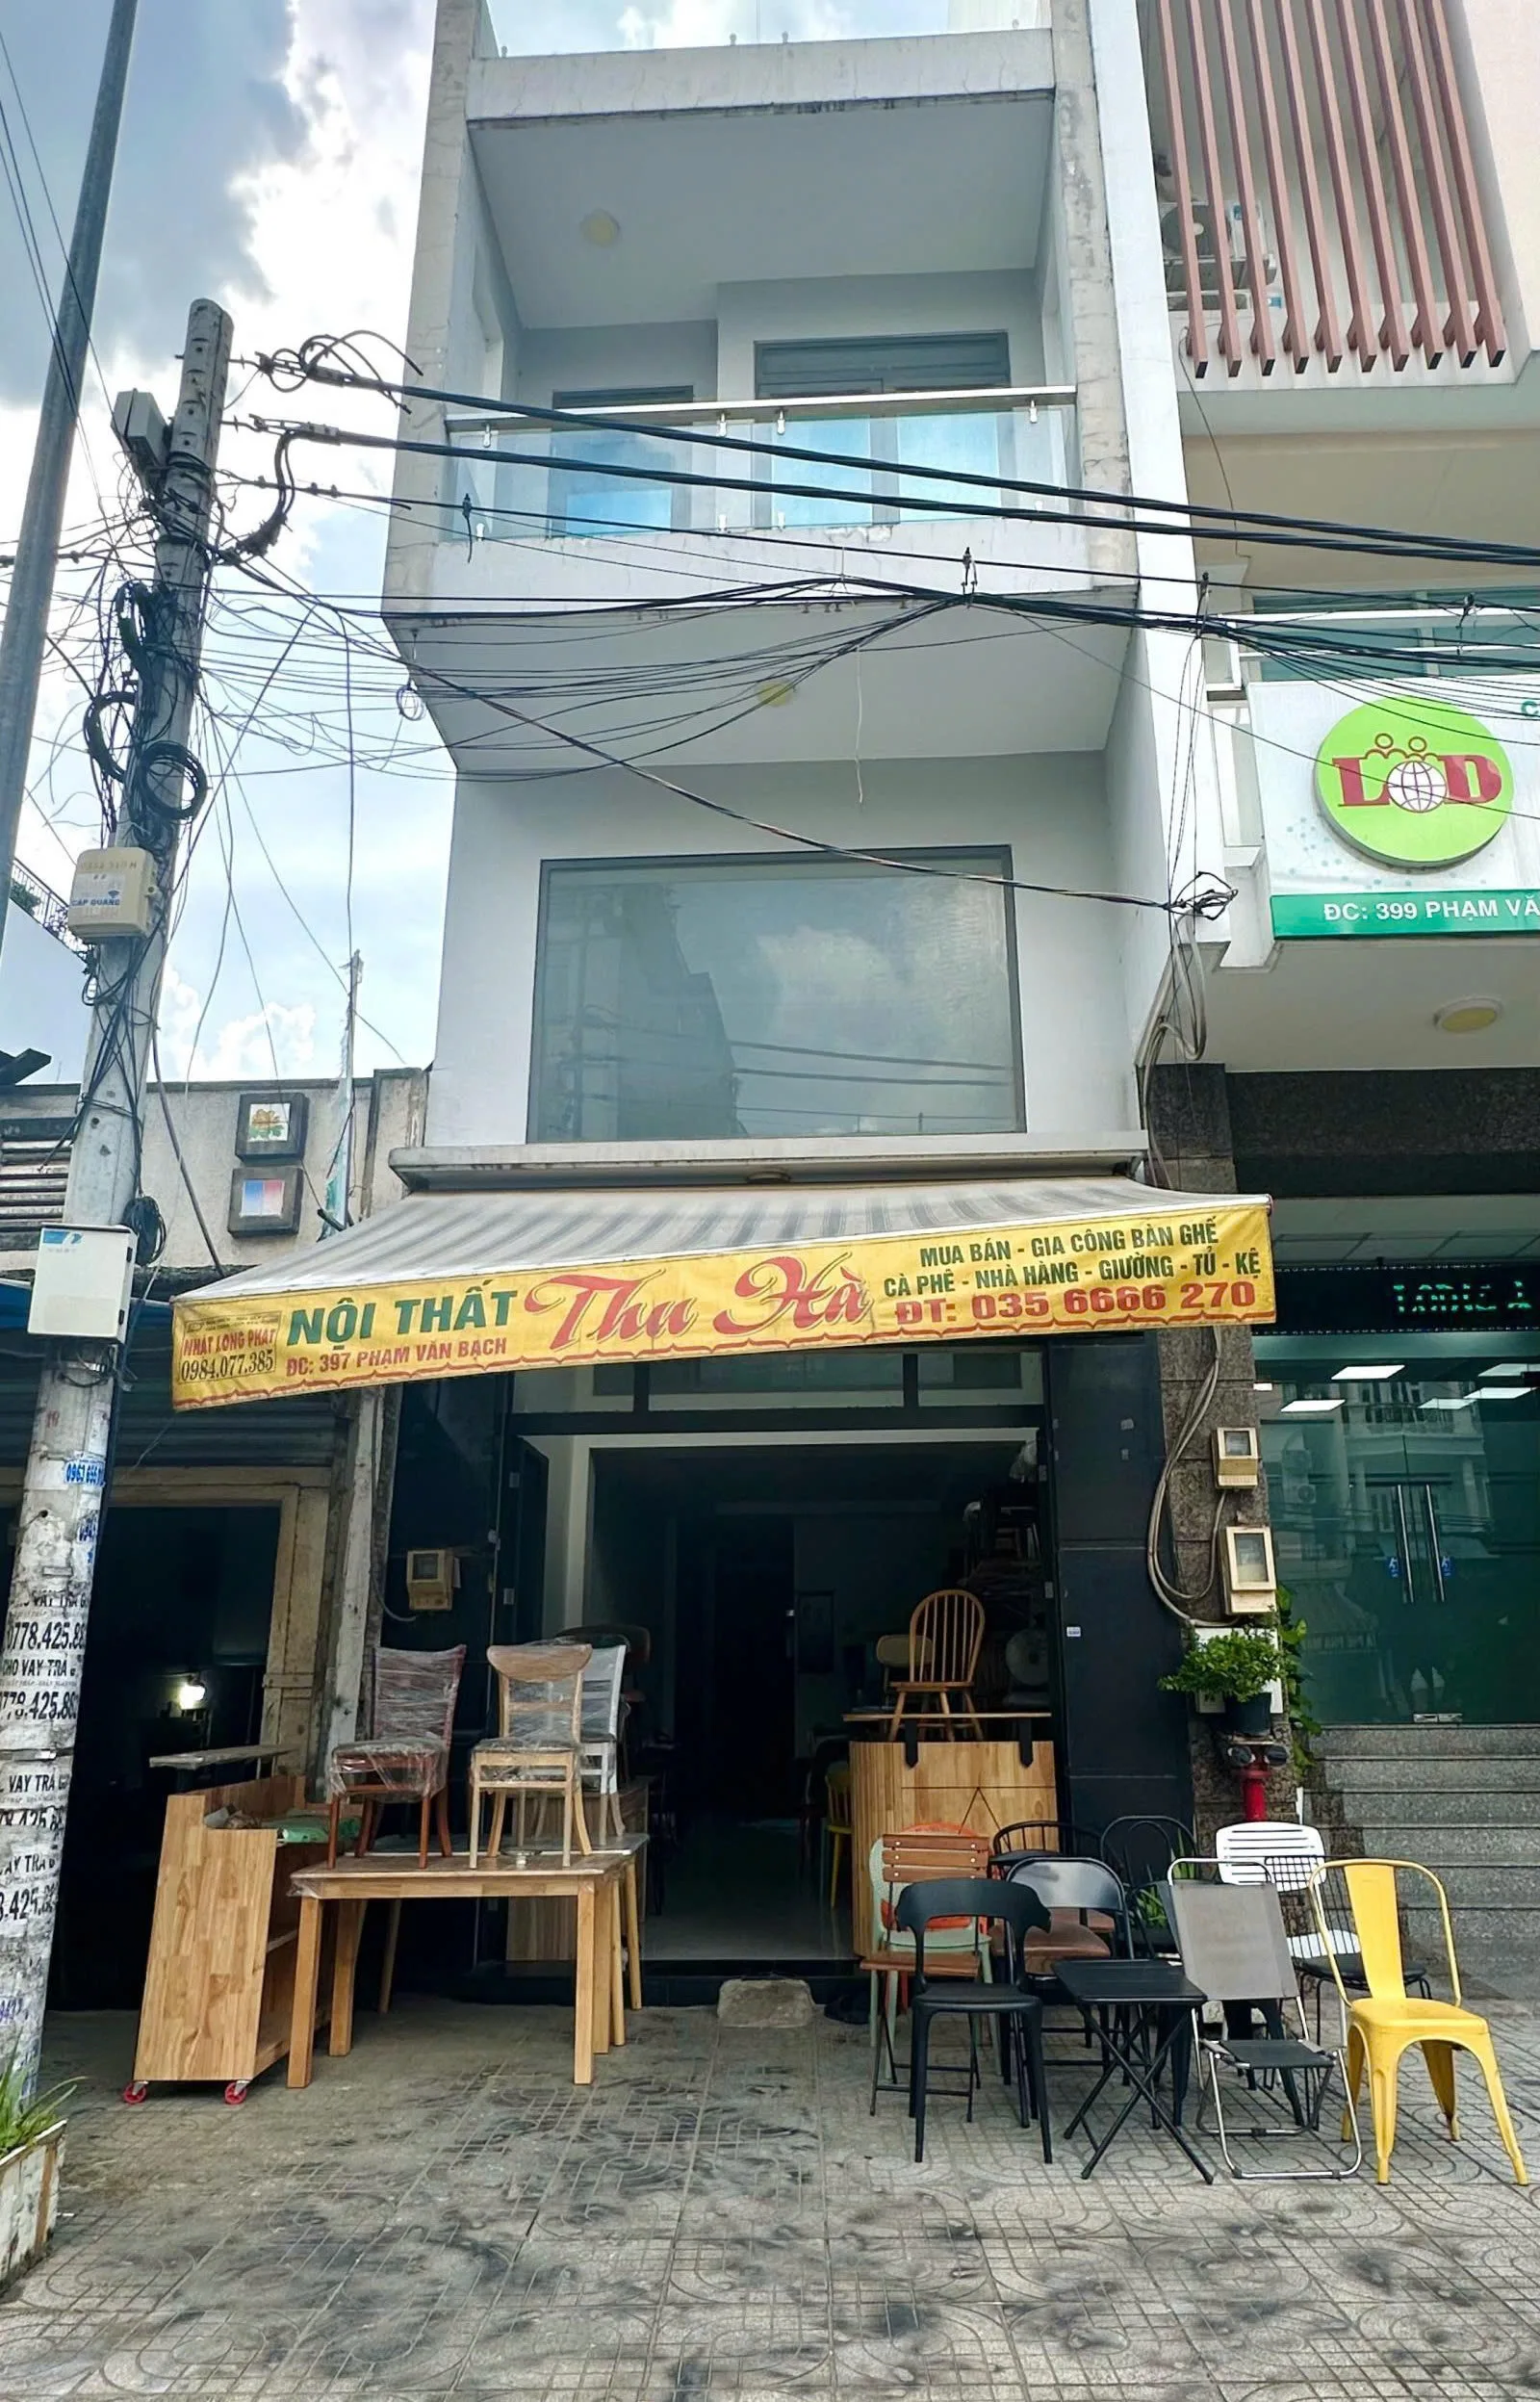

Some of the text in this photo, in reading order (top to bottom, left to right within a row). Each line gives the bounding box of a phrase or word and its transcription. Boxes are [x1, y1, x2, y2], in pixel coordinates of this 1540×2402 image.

[1323, 903, 1368, 921] ĐC:
[1375, 902, 1417, 919] 399
[1424, 899, 1498, 921] PHẠM
[920, 1245, 964, 1267] MUA
[970, 1238, 1011, 1262] BÁN
[1031, 1234, 1065, 1257] GIA
[1070, 1228, 1125, 1253] CÔNG
[1131, 1224, 1173, 1248] BÀN
[1180, 1216, 1219, 1246] GHẾ
[884, 1273, 911, 1297] CÀ
[917, 1269, 955, 1295] PHÊ
[975, 1264, 1017, 1289] NHÀ
[1023, 1260, 1079, 1285] HÀNG
[1099, 1253, 1173, 1280] GIƯỜNG
[1193, 1246, 1216, 1276] TỦ
[1235, 1247, 1261, 1278] KỆ
[287, 1279, 518, 1350] NỘI THẤT
[525, 1252, 874, 1351] Thu Hà
[894, 1281, 1255, 1325] ĐT: 035 6666 270
[215, 1330, 244, 1354] LONG
[286, 1337, 507, 1377] ĐC: 397 PHẠM VĂN BẠCH
[181, 1349, 273, 1382] 0984.077.385
[22, 1659, 43, 1676] VAY
[10, 1774, 32, 1793] VAY
